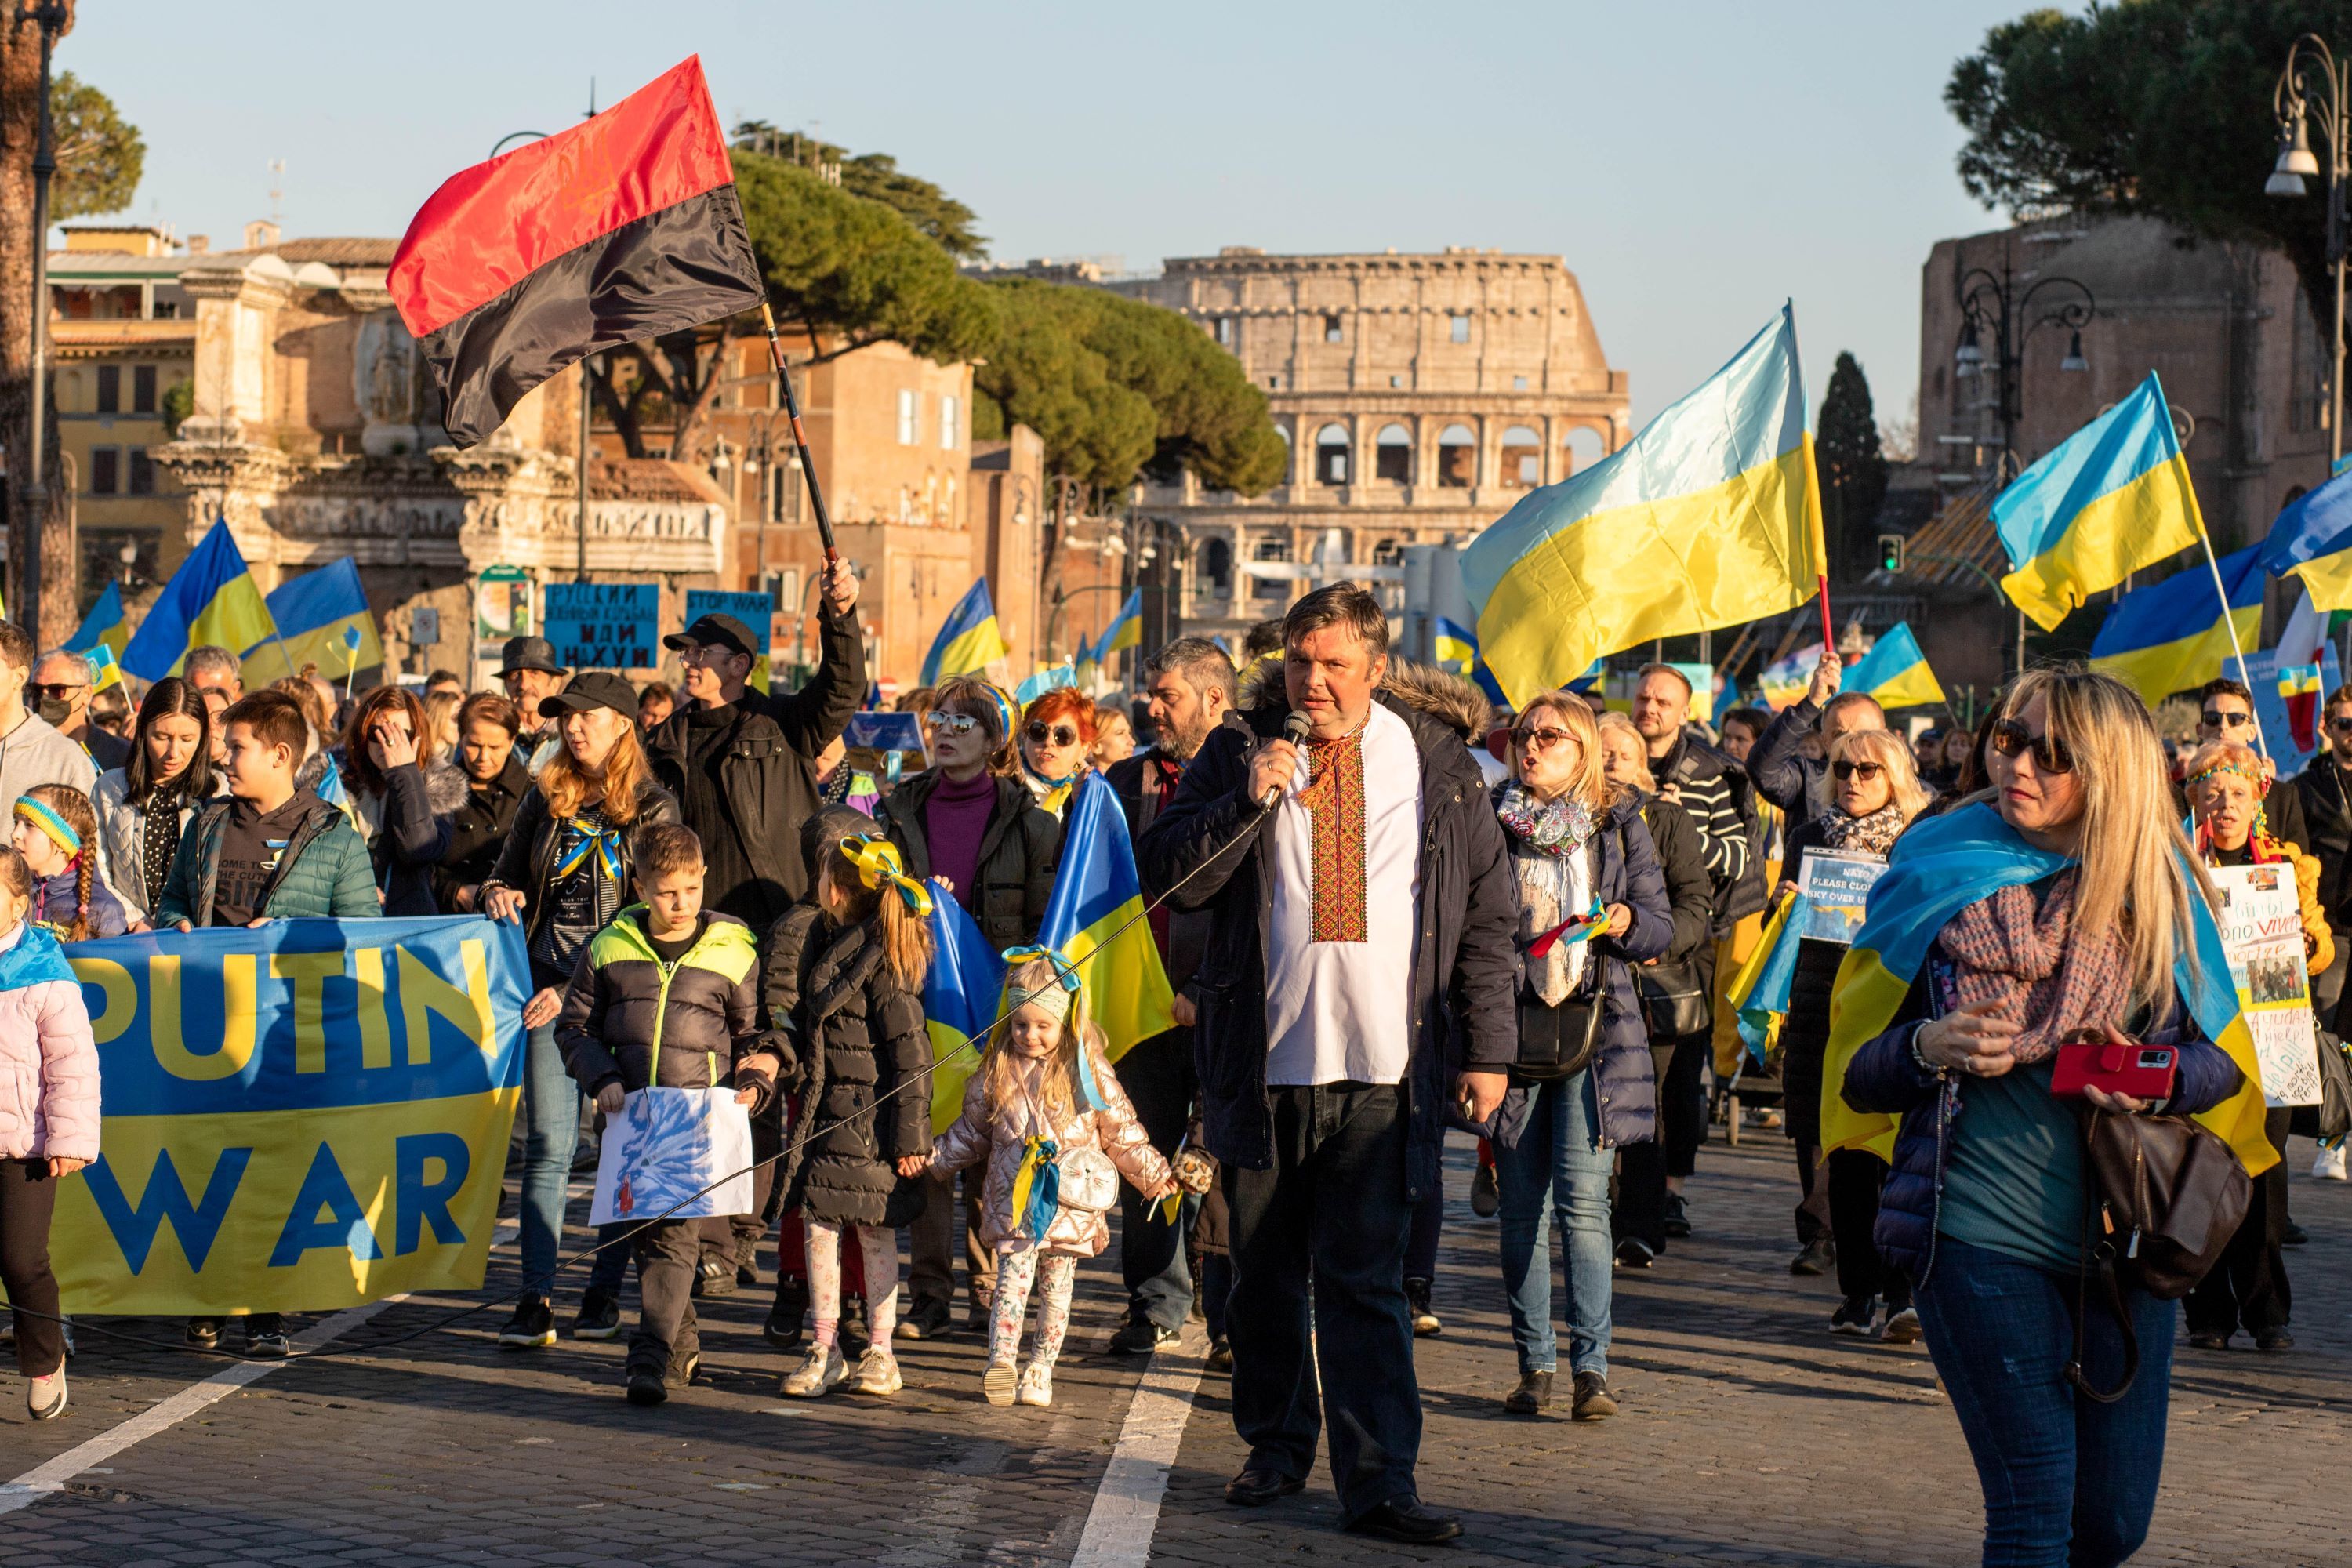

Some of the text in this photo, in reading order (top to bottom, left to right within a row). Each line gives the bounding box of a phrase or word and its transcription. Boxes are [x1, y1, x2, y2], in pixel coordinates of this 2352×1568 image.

[688, 593, 769, 613] STOP WAR
[1812, 877, 1847, 889] PLEASE
[1808, 890, 1867, 905] SKY OVER U
[67, 938, 498, 1081] PUTIN
[2292, 1085, 2303, 1099] 100
[81, 1132, 471, 1276] WAR
